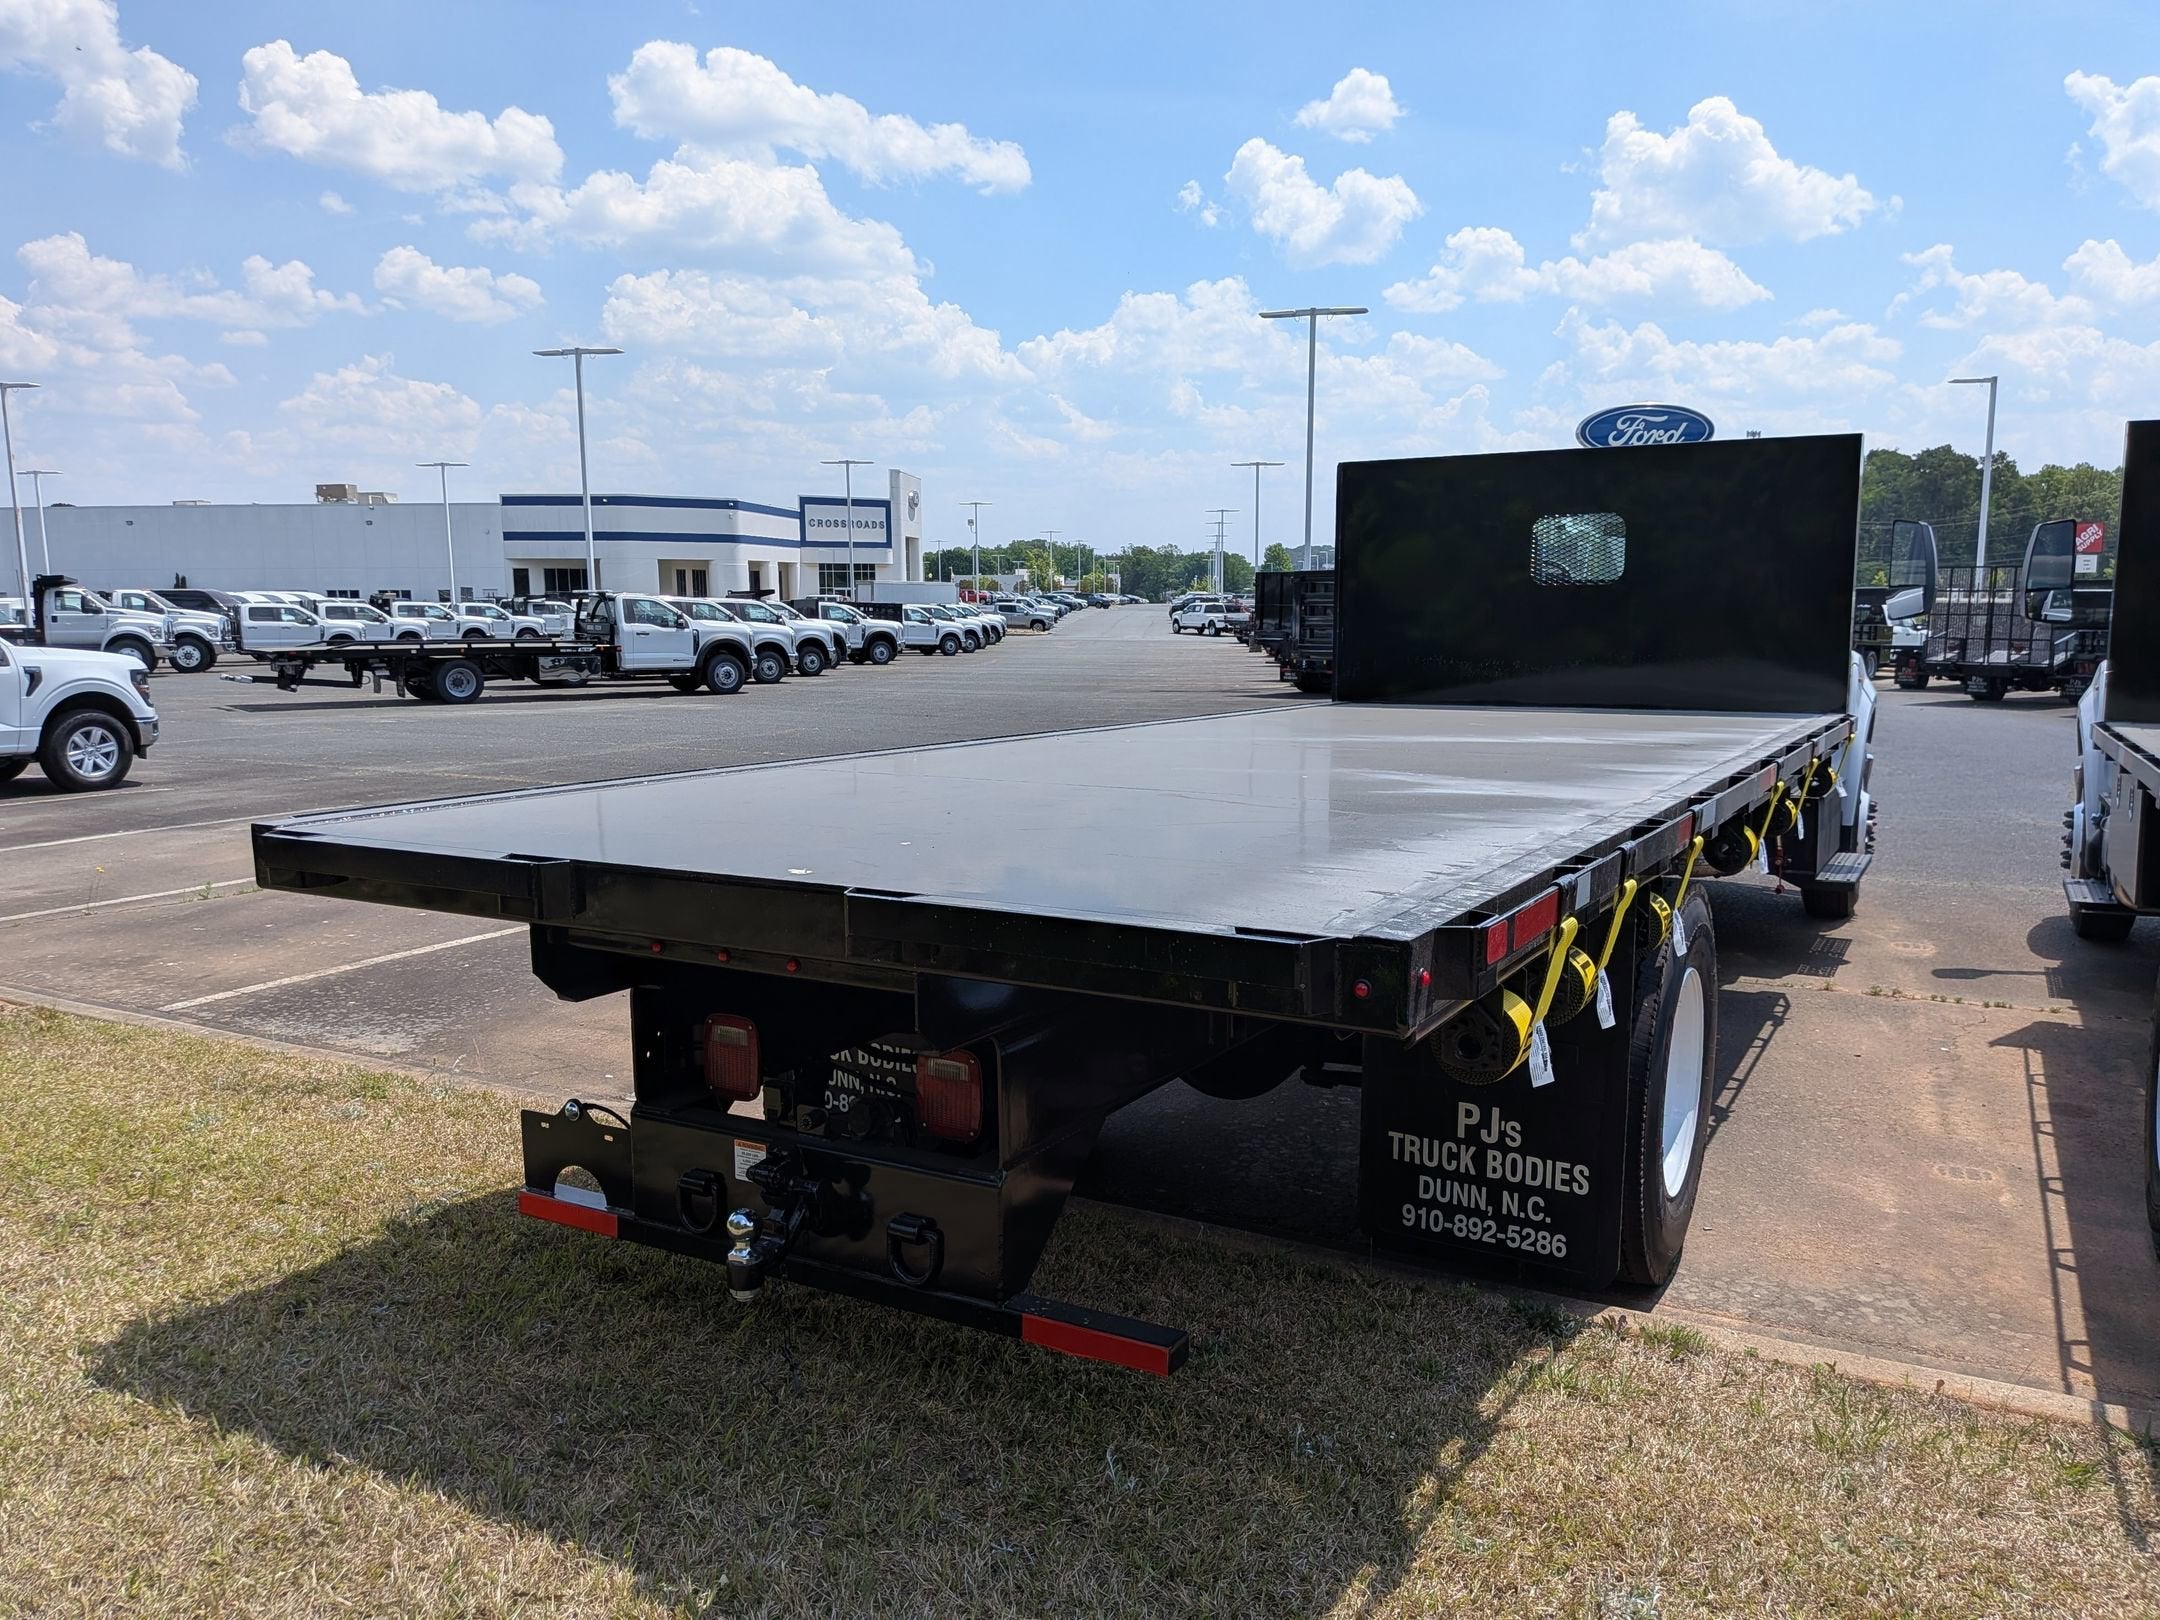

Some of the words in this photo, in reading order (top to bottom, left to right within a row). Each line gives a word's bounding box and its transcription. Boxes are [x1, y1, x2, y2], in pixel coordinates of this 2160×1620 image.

[1607, 414, 1689, 446] Ford
[2075, 523, 2099, 546] AGRI
[2076, 529, 2103, 553] SUPPLY
[1457, 1101, 1522, 1148] PJ's
[1388, 1131, 1477, 1175] TRUCK
[1486, 1149, 1590, 1196] BODIES
[1418, 1175, 1493, 1216] DUNN,
[1501, 1190, 1552, 1224] N.C.
[1401, 1203, 1567, 1258] 910-892-5286
